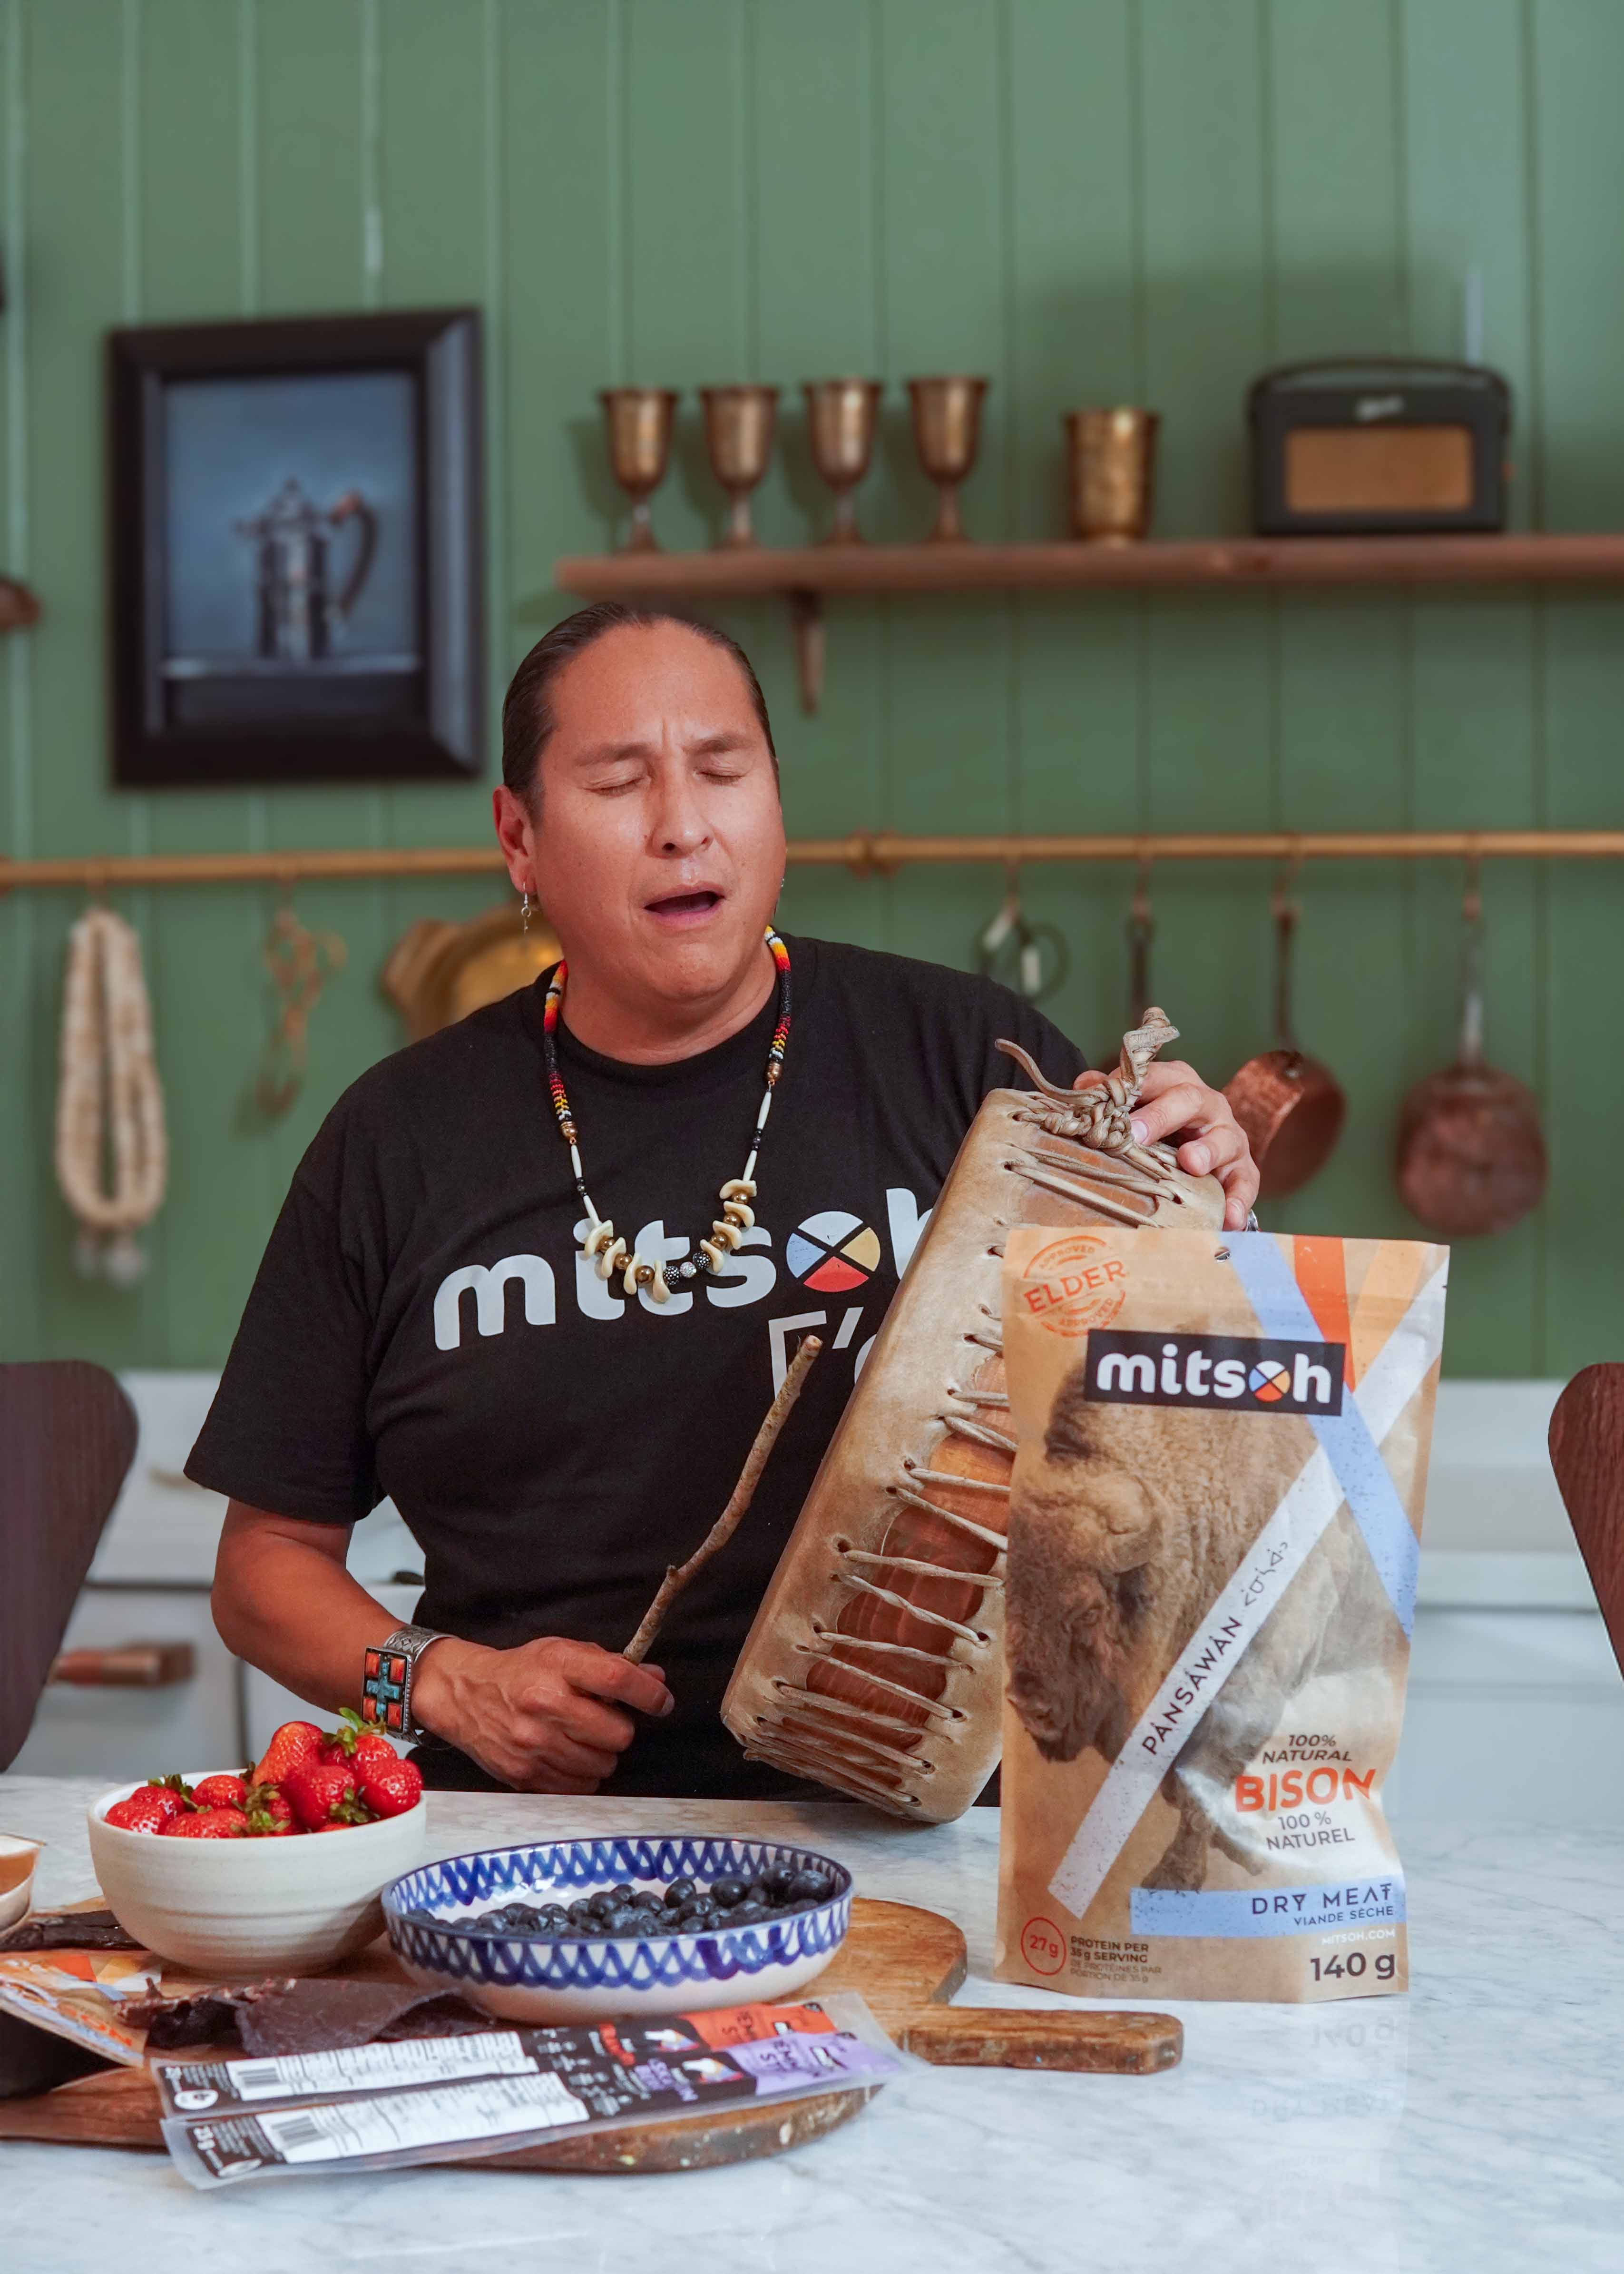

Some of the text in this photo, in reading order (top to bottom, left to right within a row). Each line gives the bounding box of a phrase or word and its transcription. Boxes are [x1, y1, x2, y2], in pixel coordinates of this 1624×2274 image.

[1024, 1260, 1126, 1312] ELDER
[1097, 1343, 1331, 1404] mitsoh
[1288, 1734, 1336, 1747] 100%
[1262, 1749, 1352, 1764] NATURAL
[1235, 1766, 1376, 1812] BISON
[1278, 1813, 1310, 1831] 100
[1266, 1828, 1355, 1850] NATUREL
[1252, 1883, 1392, 1915] DRY MEAT
[1294, 1912, 1344, 1926] VIANDE
[1071, 1936, 1149, 1952] PROTEIN PER
[1322, 1929, 1395, 1945] MITSOH.COM
[1094, 1951, 1148, 1963] SERVING
[1311, 1952, 1395, 1981] 140 g
